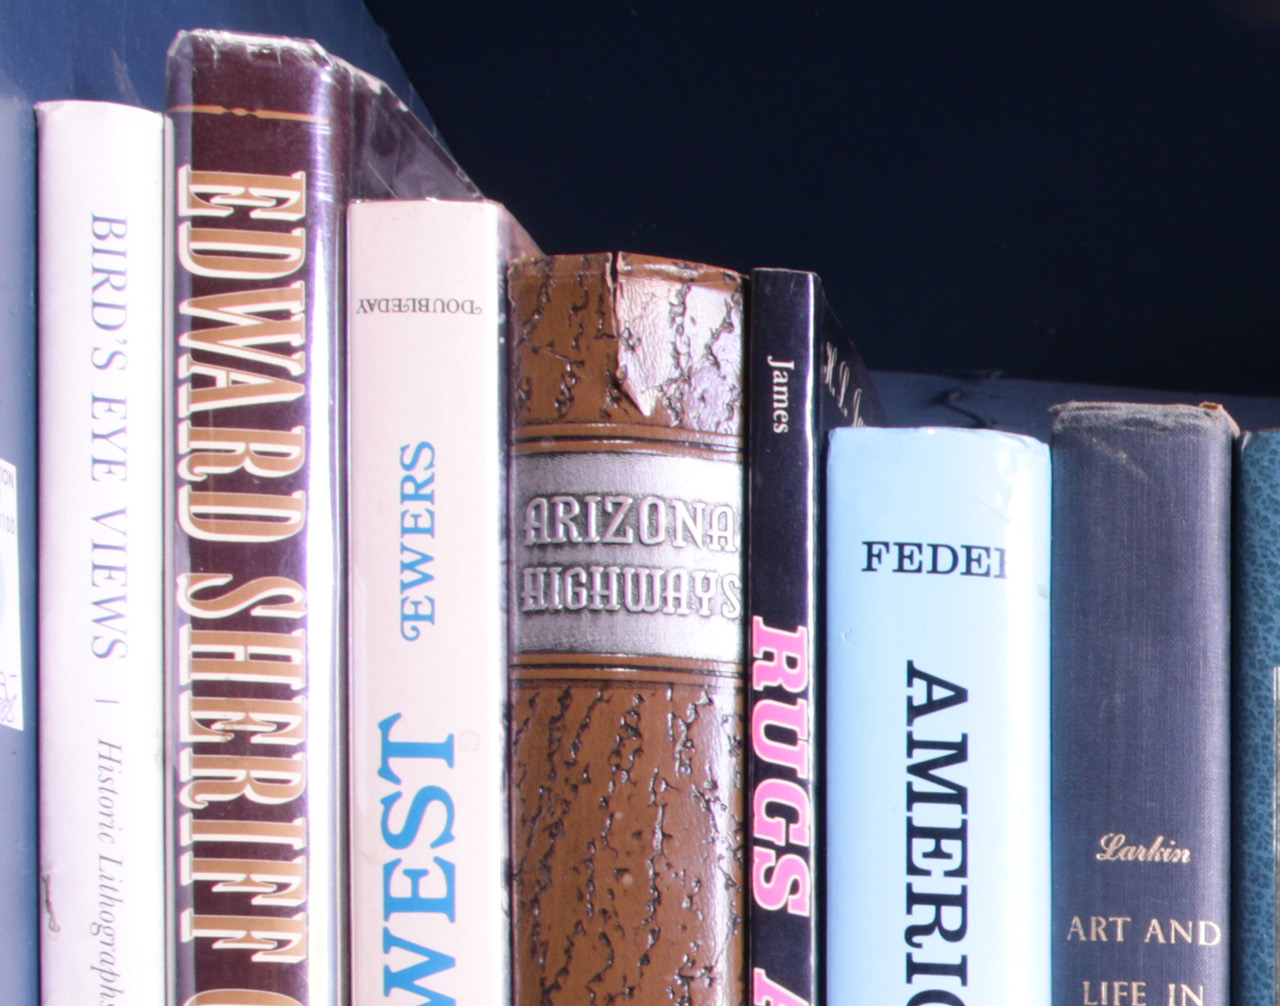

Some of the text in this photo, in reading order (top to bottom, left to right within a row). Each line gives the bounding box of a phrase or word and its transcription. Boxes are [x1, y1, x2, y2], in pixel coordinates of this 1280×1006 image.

[178, 164, 305, 541] EDWARD
[767, 355, 795, 434] James
[90, 211, 128, 661] BIRD'S EYE VIEWS
[400, 440, 435, 641] EWERS
[523, 497, 739, 553] ARIZONA
[521, 565, 743, 620] HIGHWAYS
[97, 739, 122, 845] Historic
[178, 571, 307, 963] SHERIFF
[751, 614, 811, 917] RUGS
[1096, 833, 1190, 864] Larkin
[89, 857, 125, 1004] Lithographs
[1067, 917, 1221, 946] ART AND
[1082, 982, 1147, 1006] LIFE
